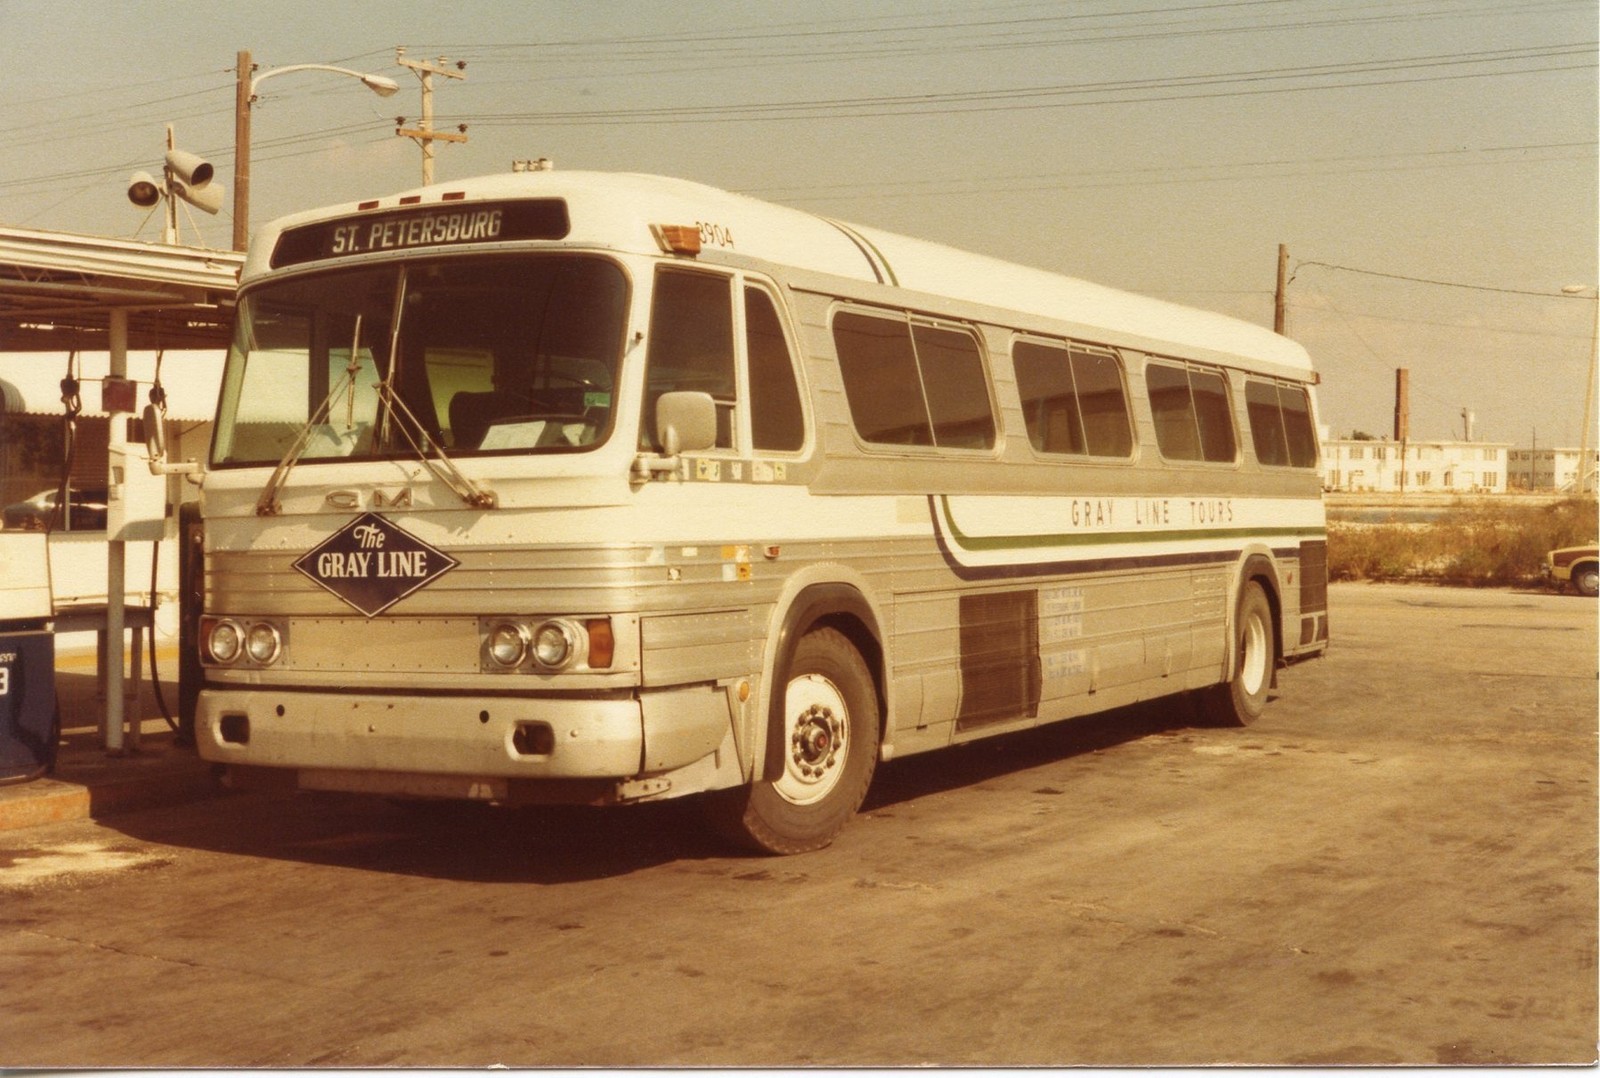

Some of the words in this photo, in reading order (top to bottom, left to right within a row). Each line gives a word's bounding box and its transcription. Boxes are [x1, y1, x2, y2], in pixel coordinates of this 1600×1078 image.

[332, 225, 359, 253] ST.
[368, 210, 502, 250] PETERSBURG
[695, 221, 734, 249] 3904
[1071, 498, 1114, 527] GRAY
[1135, 499, 1170, 525] LINE
[1190, 499, 1233, 525] TOURS
[353, 523, 386, 549] The
[318, 551, 371, 578] GRAY
[377, 551, 427, 578] LINE
